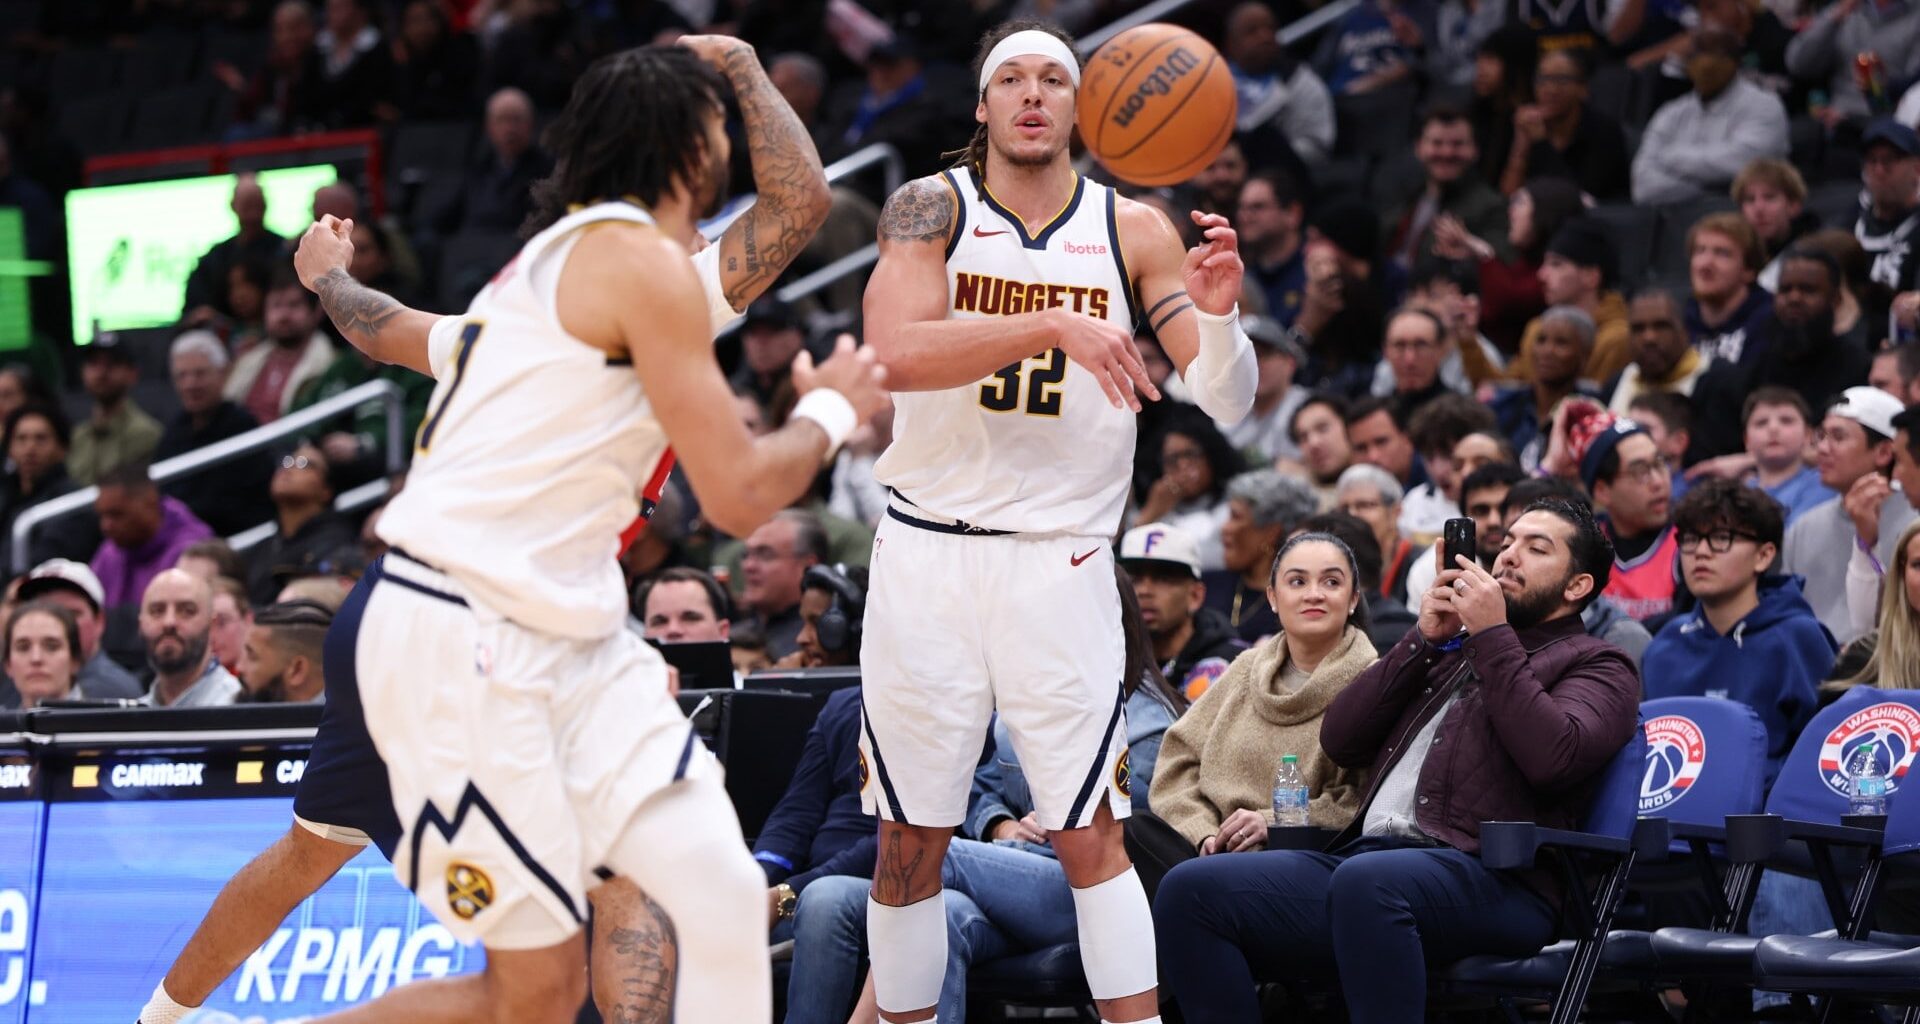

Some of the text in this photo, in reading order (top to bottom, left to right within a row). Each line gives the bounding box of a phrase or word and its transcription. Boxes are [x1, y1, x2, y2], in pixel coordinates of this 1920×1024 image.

[1112, 47, 1199, 127] Wilson
[1064, 241, 1107, 254] ibotta
[954, 272, 1110, 320] NUGGETS
[979, 348, 1067, 416] 32
[1145, 531, 1164, 555] F
[1645, 719, 1699, 747] SHINGTON
[1846, 706, 1920, 735] WASHINGTON
[1639, 790, 1673, 809] ARDS
[234, 923, 456, 1003] KPMG
